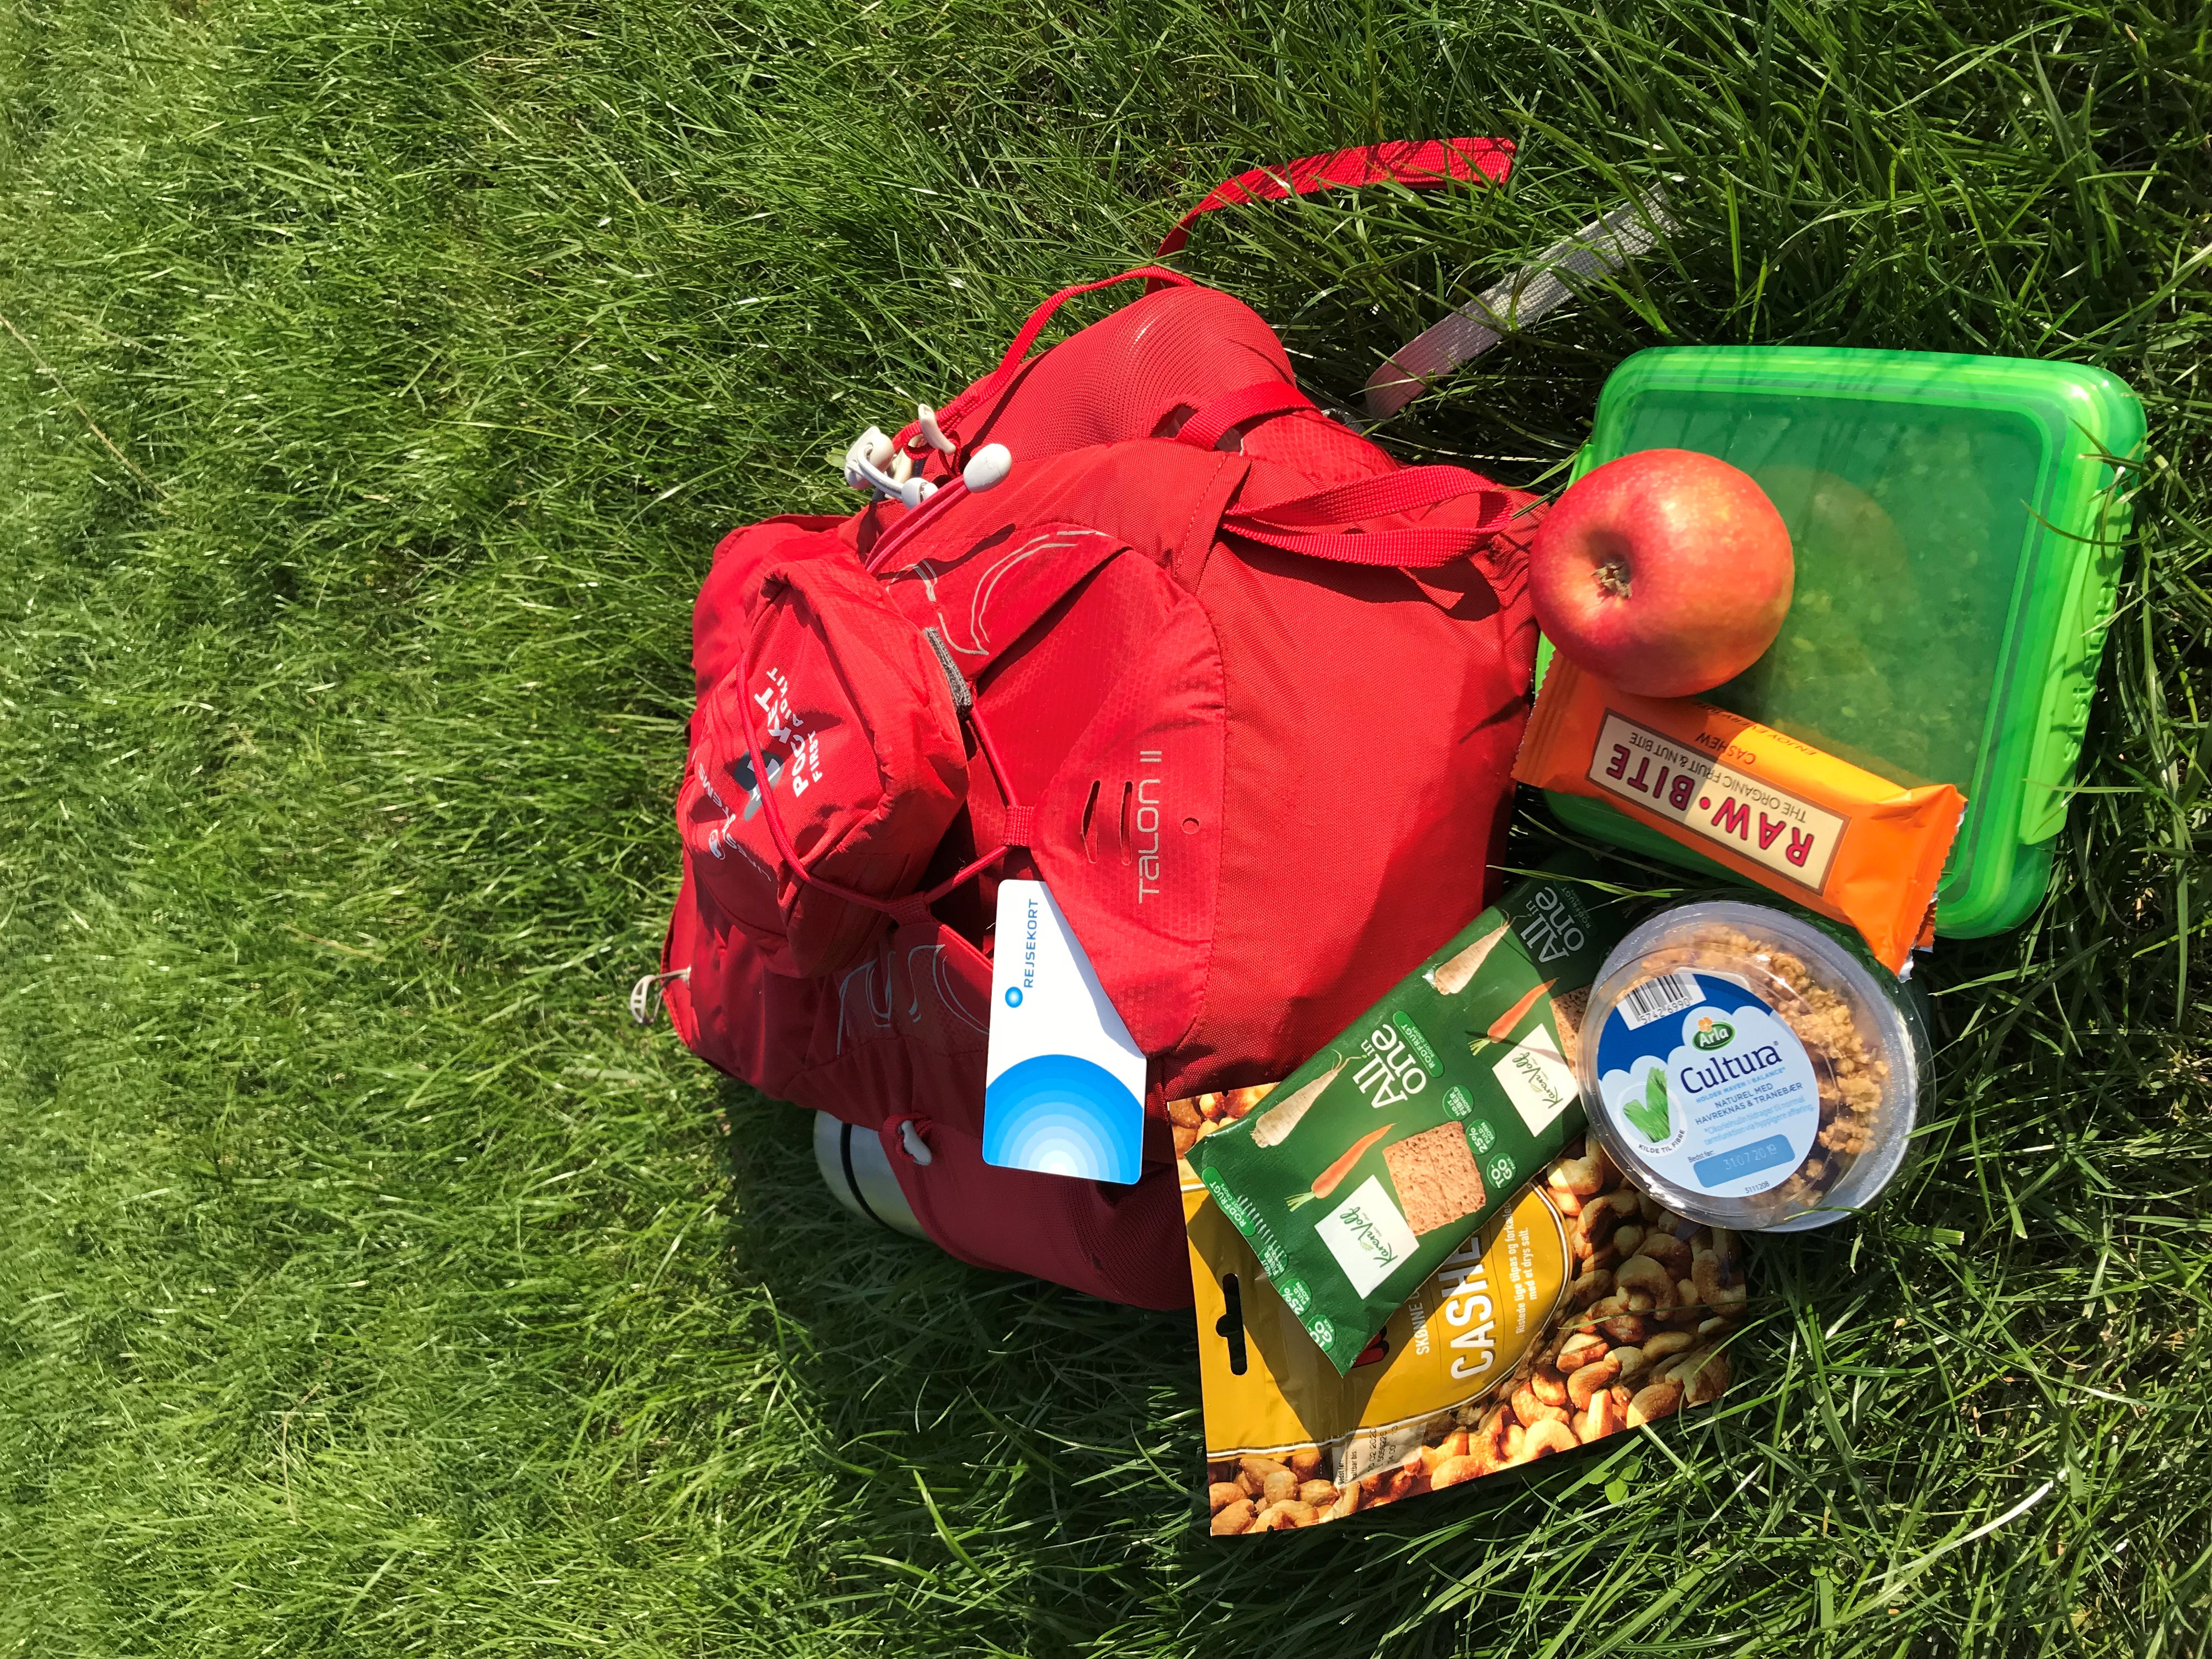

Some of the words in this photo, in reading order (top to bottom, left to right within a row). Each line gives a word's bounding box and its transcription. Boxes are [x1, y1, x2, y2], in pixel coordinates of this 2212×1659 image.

[766, 668, 788, 698] KIT
[2064, 587, 2117, 761] sistema
[780, 698, 804, 727] AID
[1726, 714, 1767, 735] EVERY
[754, 687, 808, 797] POCKET
[1629, 732, 1654, 752] BITE
[1653, 744, 1680, 764] NUT
[1695, 732, 1757, 764] CASHEW
[1767, 734, 1818, 755] ENJOY
[808, 731, 822, 782] FIRST
[1679, 755, 1689, 768] &
[1606, 743, 1695, 811] BITE
[1688, 760, 1720, 783] FRUIT
[1722, 776, 1781, 809] ORGANIC
[1781, 802, 1807, 823] THE
[1711, 796, 1814, 868] RAW
[1526, 900, 1539, 917] in
[1535, 887, 1584, 951] one
[1024, 899, 1039, 988] REJSEKORT
[1520, 913, 1570, 963] All
[1640, 1008, 1664, 1024] 5742
[1667, 997, 1691, 1014] 6990
[1401, 1024, 1436, 1069] RODFRUGT
[1412, 1026, 1425, 1042] CROPS
[1699, 1027, 1729, 1047] Arla
[1361, 1039, 1375, 1059] in
[1371, 1024, 1426, 1094] one
[1512, 1052, 1541, 1083] Volf
[1680, 1045, 1782, 1094] Cultura
[1352, 1053, 1408, 1108] All
[1536, 1075, 1564, 1109] Karen
[1695, 1090, 1723, 1103] HOLDER
[1723, 1082, 1747, 1093] MAVEN
[1449, 1091, 1467, 1116] FIBER
[1454, 1086, 1472, 1114] INDHOLD
[1695, 1103, 1746, 1125] HAVREKNAS
[1753, 1082, 1804, 1104] TRANEBÆR
[1714, 1090, 1753, 1108] NATUREL
[1753, 1083, 1774, 1095] MED
[1469, 1127, 1488, 1154] 25%
[1481, 1121, 1495, 1141] KORN
[1638, 1143, 1660, 1154] KILDE
[1661, 1144, 1672, 1153] TIL
[1673, 1129, 1685, 1148] FIBRE
[1498, 1158, 1513, 1180] GO
[1507, 1156, 1516, 1170] PACK
[1688, 1153, 1702, 1163] Bedst
[1491, 1164, 1505, 1188] TO-
[1745, 1181, 1770, 1194] 5111208
[1210, 1181, 1246, 1227] RODFRUGT
[1220, 1183, 1233, 1200] CROPS
[1340, 1206, 1373, 1240] Volf
[1367, 1231, 1398, 1268] Karen
[1508, 1243, 1519, 1255] og
[1518, 1227, 1531, 1250] salt.
[1264, 1252, 1279, 1276] FIBER
[1510, 1255, 1522, 1283] tilpas
[1521, 1250, 1534, 1269] drys
[1525, 1269, 1533, 1279] et
[1282, 1288, 1304, 1315] 25%
[1295, 1281, 1310, 1302] KORN
[1515, 1283, 1526, 1301] lige
[1525, 1280, 1538, 1300] med
[1437, 1237, 1494, 1380] CASHE
[1514, 1301, 1526, 1334] Ristede
[1314, 1321, 1333, 1342] GO
[1323, 1318, 1334, 1333] PACK
[1409, 1302, 1430, 1356] SKØNNE
